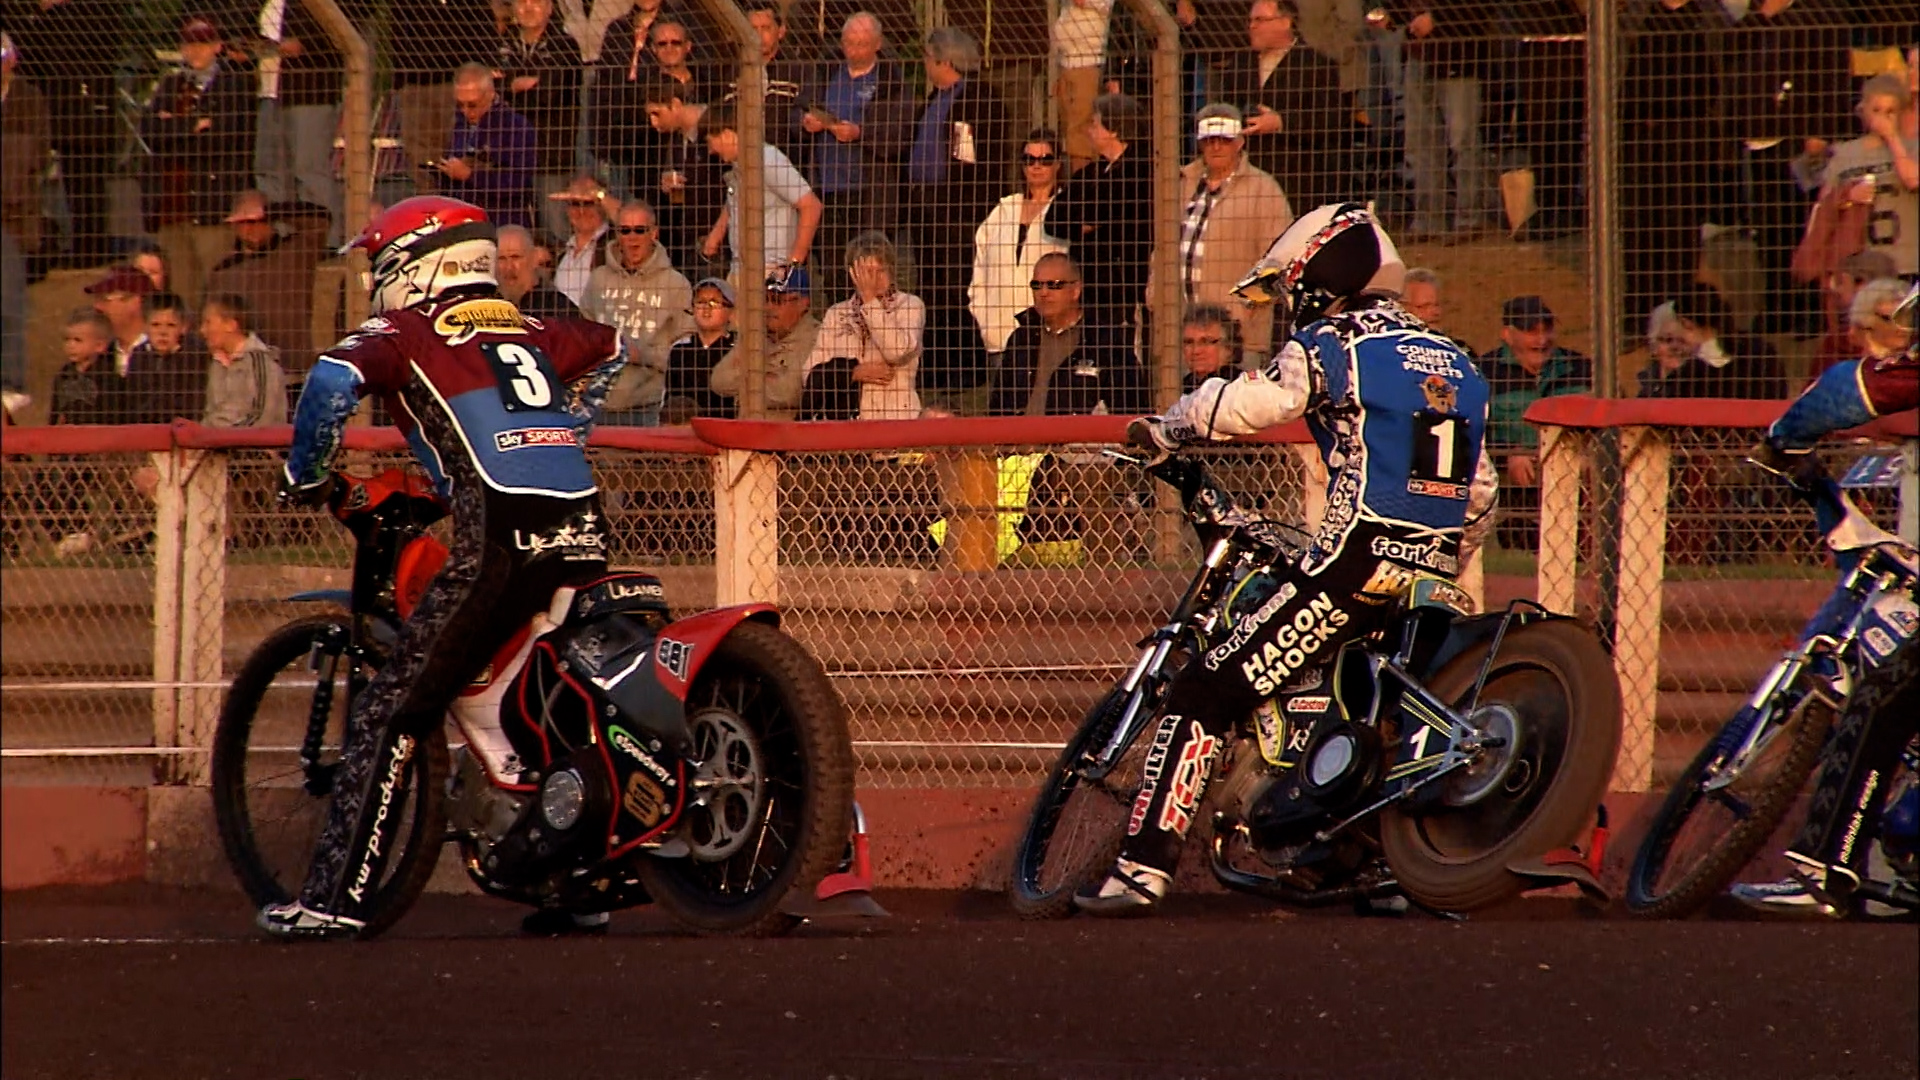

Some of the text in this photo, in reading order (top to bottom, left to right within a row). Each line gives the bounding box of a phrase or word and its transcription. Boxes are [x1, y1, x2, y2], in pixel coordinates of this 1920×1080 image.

[496, 343, 552, 408] 3
[1396, 345, 1457, 360] COUNTY
[1402, 361, 1464, 379] PALLETS
[499, 430, 576, 447] sky SPORTS
[1430, 419, 1455, 478] 1
[1241, 591, 1334, 682] HAGON
[1254, 608, 1350, 696] SHOCKS
[1410, 725, 1430, 760] 1
[1128, 715, 1182, 836] UNIFILTER
[1158, 720, 1216, 834] TCX
[348, 734, 409, 903] kw-products
